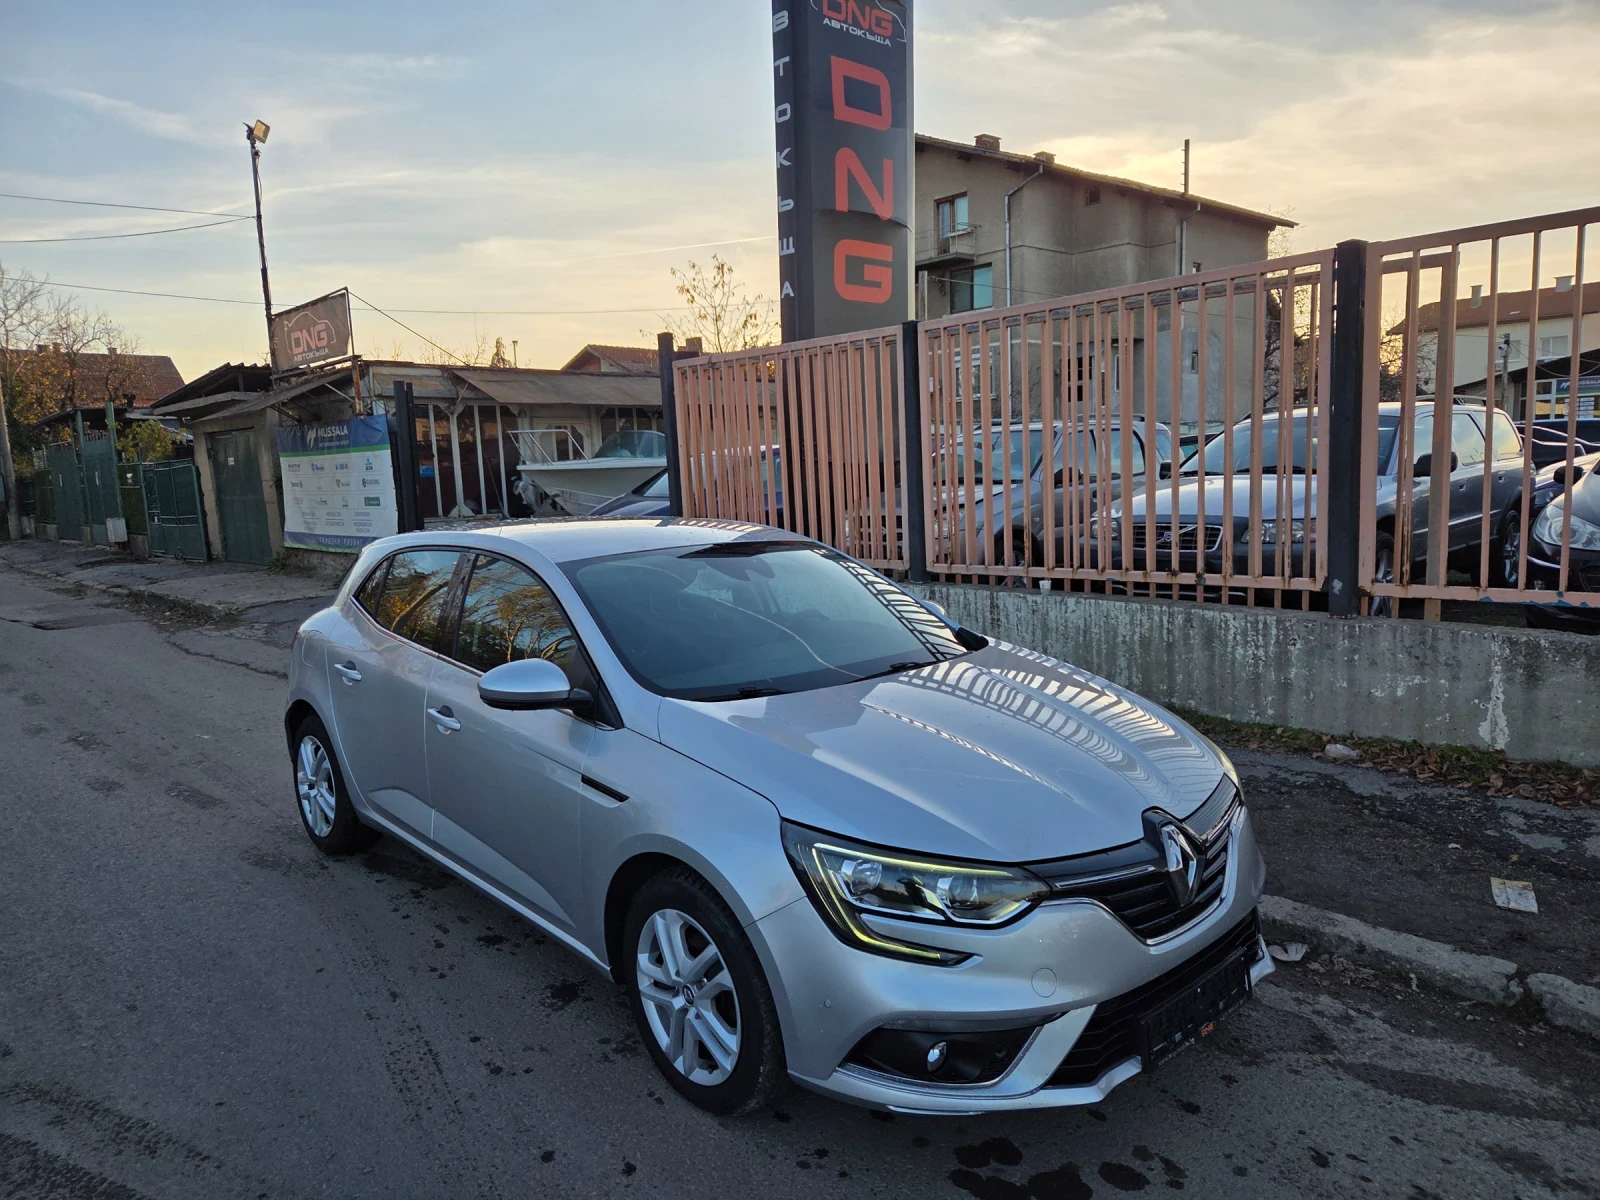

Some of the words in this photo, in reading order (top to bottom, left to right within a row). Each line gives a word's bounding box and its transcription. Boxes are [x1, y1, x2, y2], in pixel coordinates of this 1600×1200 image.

[823, 0, 892, 37] DNG
[823, 17, 892, 47] АВТОКЪЩА
[830, 55, 894, 304] DNG
[291, 323, 328, 355] DNG
[318, 425, 348, 438] MUSSALA
